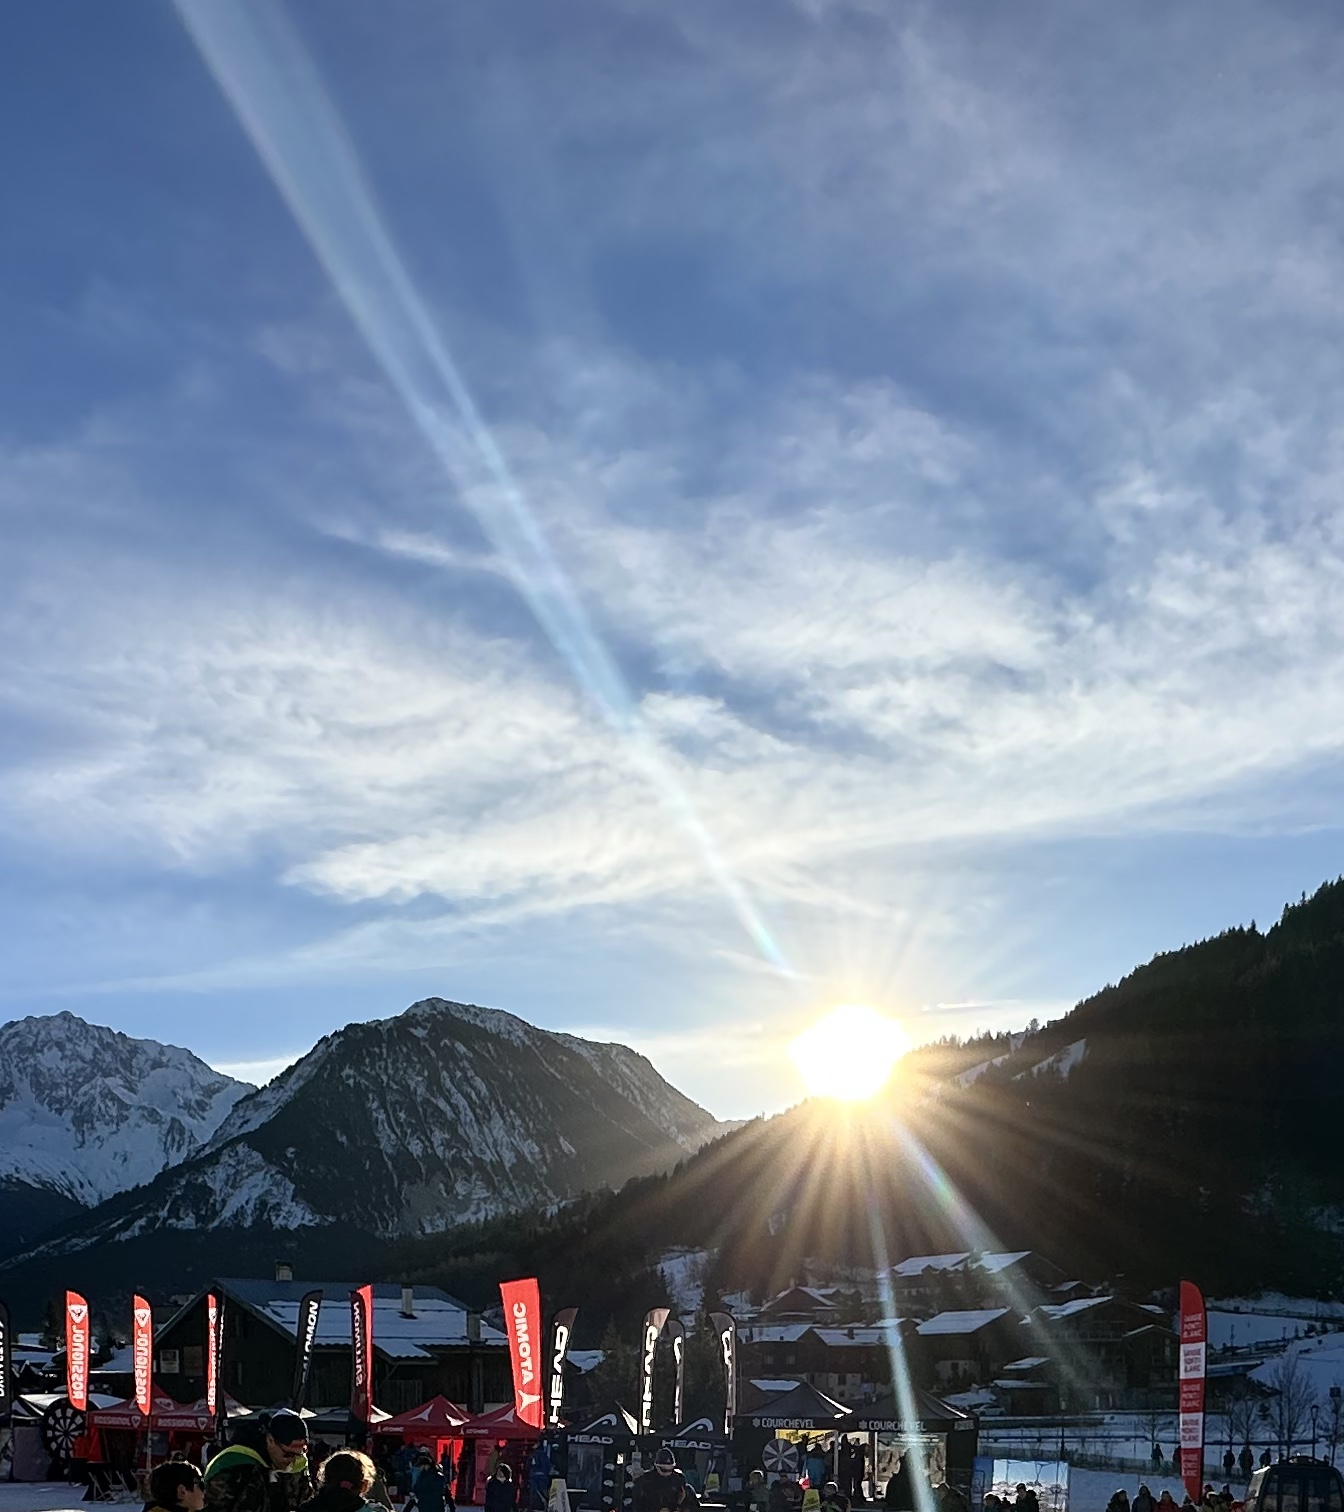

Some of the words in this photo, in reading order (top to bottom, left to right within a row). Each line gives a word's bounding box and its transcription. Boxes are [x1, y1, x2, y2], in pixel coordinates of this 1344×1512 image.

[549, 1324, 569, 1424] HEAD
[761, 1418, 816, 1429] COURCHEVEL
[567, 1434, 614, 1445] HEAD
[662, 1439, 712, 1450] HEAD
